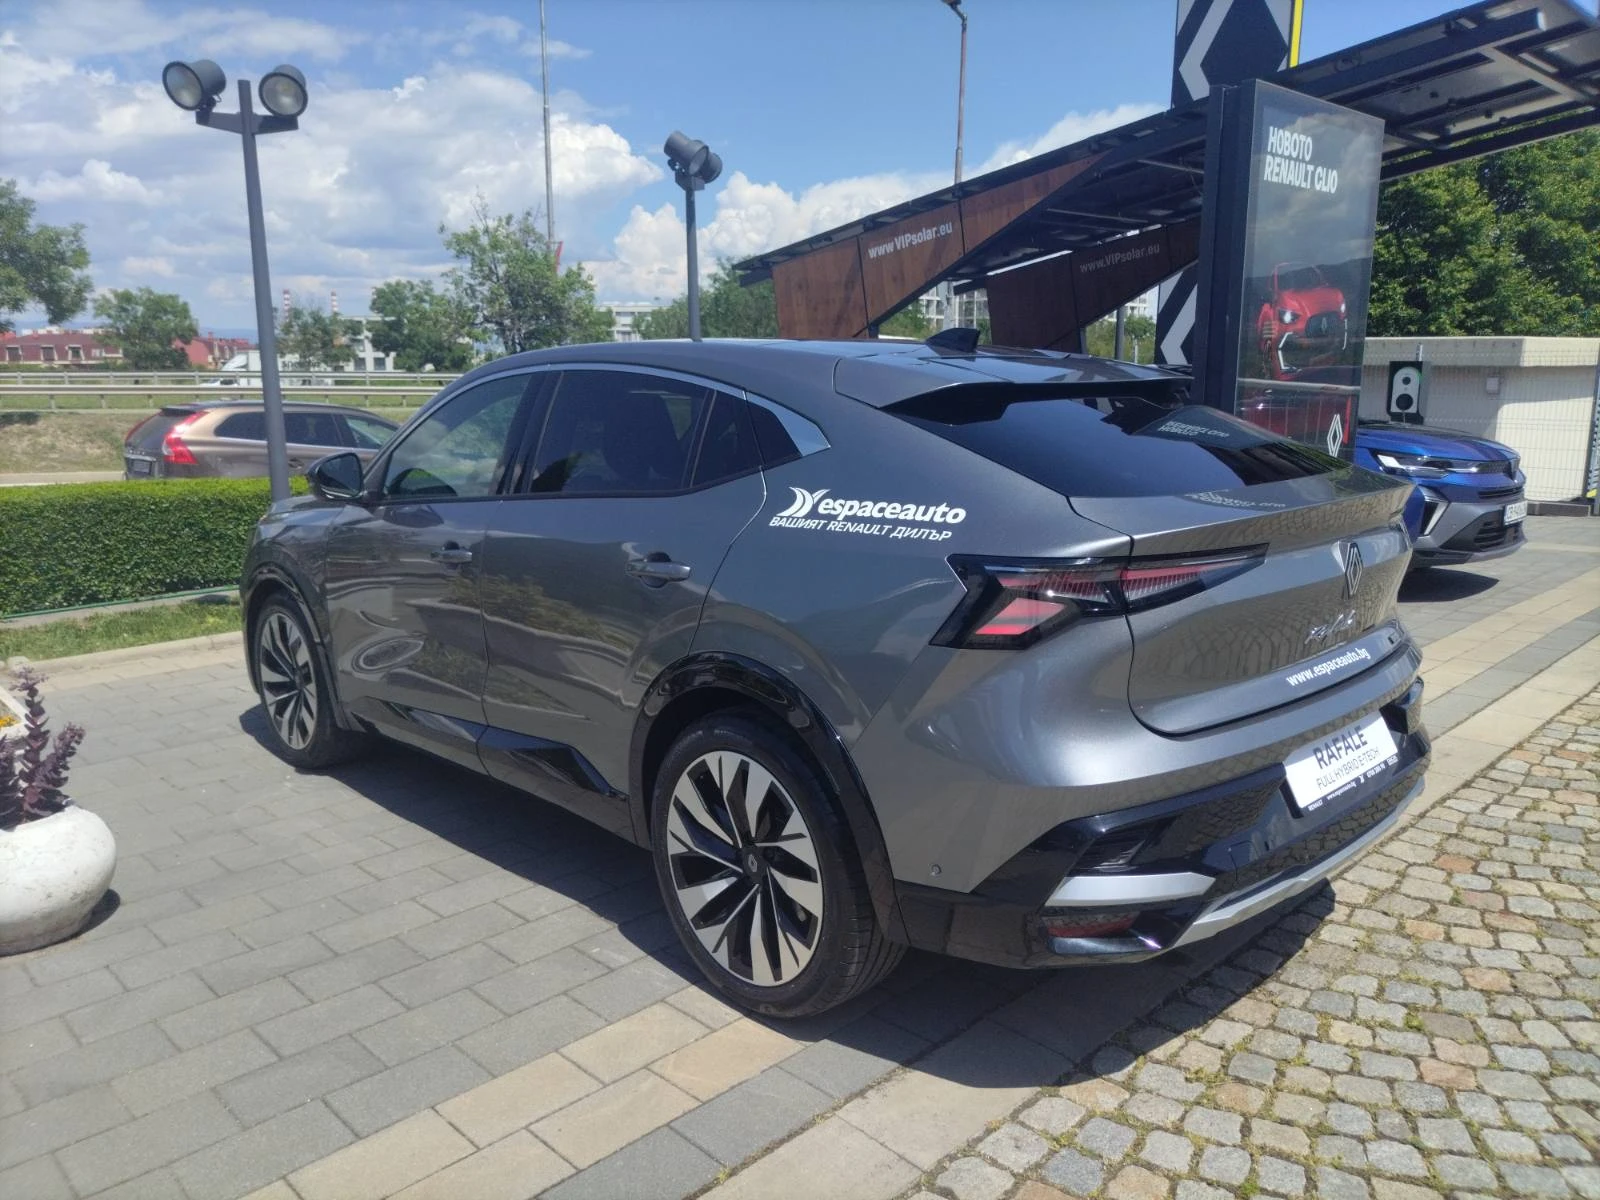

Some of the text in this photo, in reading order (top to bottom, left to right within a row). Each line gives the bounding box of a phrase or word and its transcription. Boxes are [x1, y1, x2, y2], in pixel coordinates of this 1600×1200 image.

[1264, 155, 1338, 194] RENAULT CLIO
[1080, 243, 1160, 272] www.VIPsolar.eu
[769, 516, 952, 542] ВАШИЯТ RENAULT ДИЛЪР
[818, 498, 967, 524] espaceauto
[1286, 647, 1371, 687] www.espaceauto.bg
[1313, 725, 1368, 769] RAFALE
[1316, 774, 1336, 790] FULL
[1334, 758, 1360, 780] HYBRID
[1357, 746, 1380, 766] E-TECH
